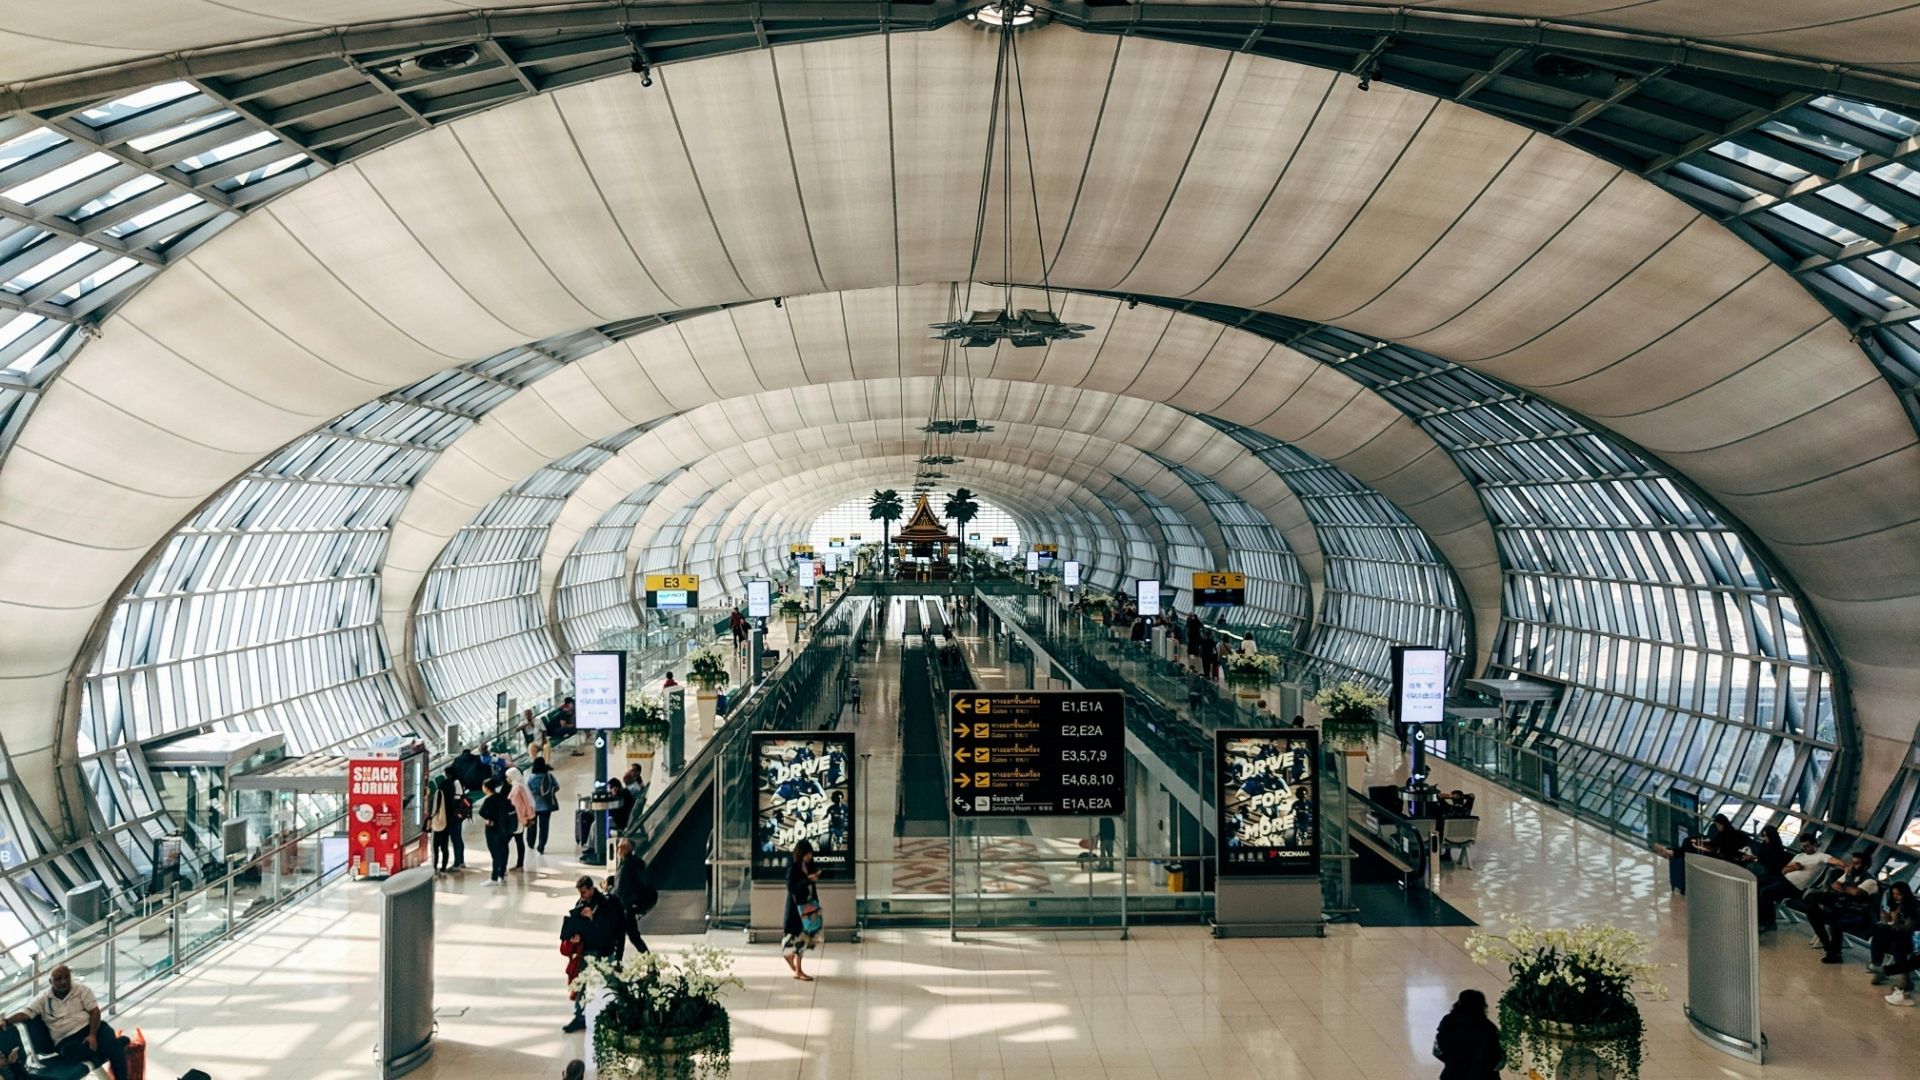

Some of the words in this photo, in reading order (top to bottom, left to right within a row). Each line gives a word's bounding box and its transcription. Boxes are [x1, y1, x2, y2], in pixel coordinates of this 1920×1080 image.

[664, 577, 680, 588] E3
[1211, 575, 1227, 586] E4
[1062, 701, 1103, 713] E1,E1A
[1061, 725, 1103, 738] E2,E2A
[1062, 750, 1107, 762] E3,5,7,9
[775, 754, 831, 784] DRIVE
[1239, 751, 1295, 780] DRIVE
[353, 767, 398, 781] SNACK
[1062, 774, 1114, 786] E4,6,8,10
[1062, 798, 1112, 810] E1A,E2A
[778, 819, 830, 847] MORE
[1244, 816, 1295, 840] MORE
